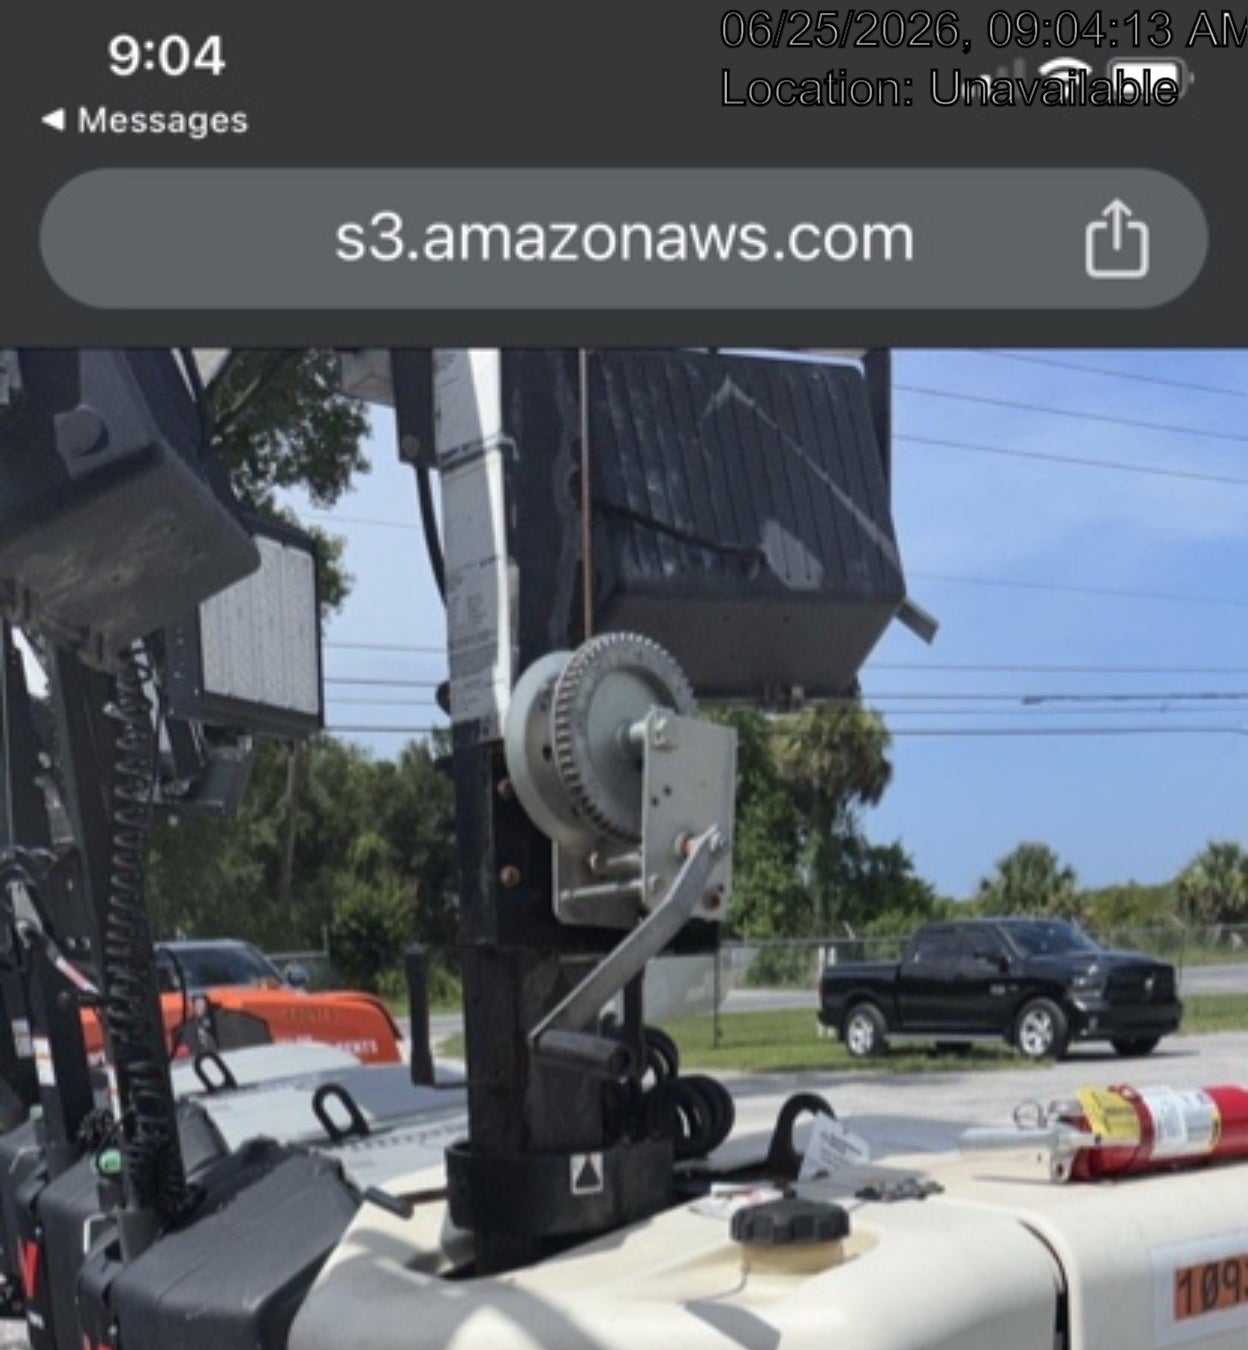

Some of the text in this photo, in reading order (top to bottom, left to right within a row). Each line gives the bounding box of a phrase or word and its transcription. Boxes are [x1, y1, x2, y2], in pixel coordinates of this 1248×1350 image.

[109, 33, 226, 76] 9:04
[78, 105, 249, 140] Messages
[336, 210, 914, 261] s3.amazonaws.com
